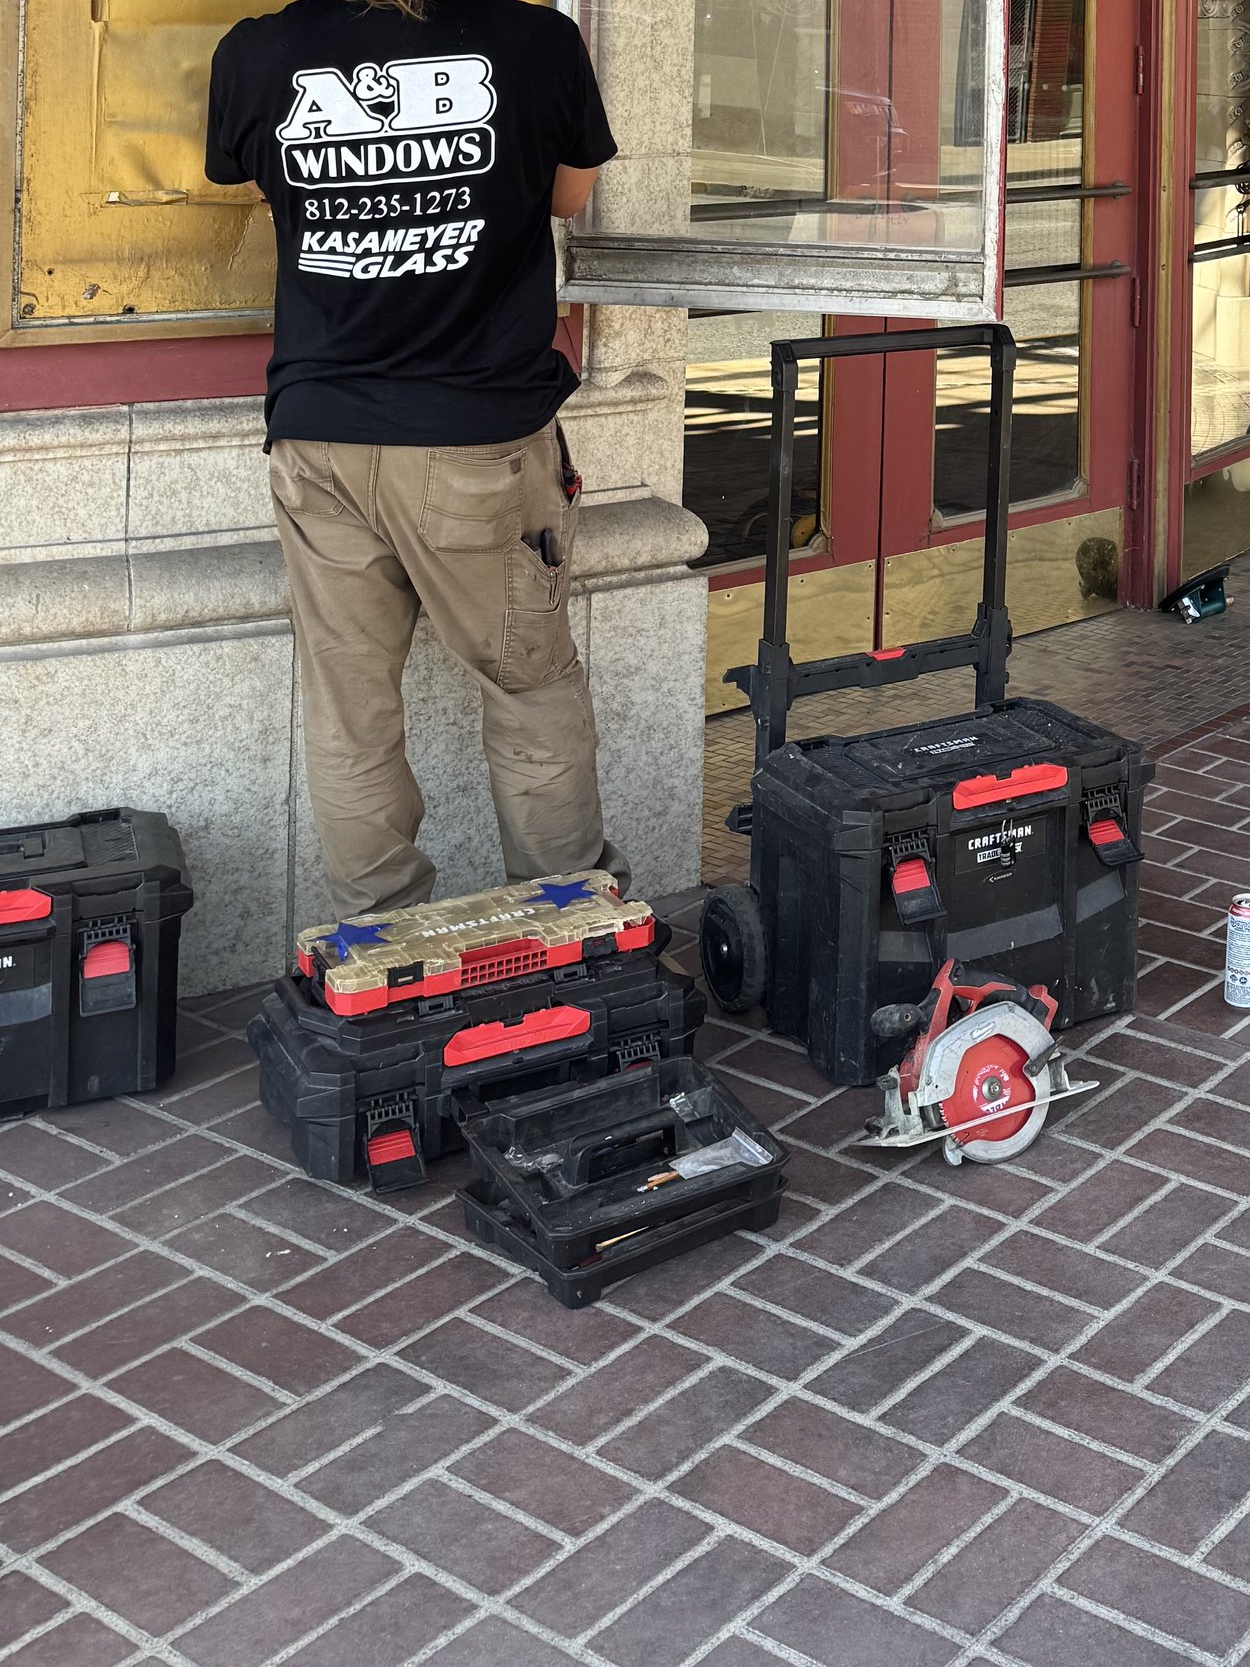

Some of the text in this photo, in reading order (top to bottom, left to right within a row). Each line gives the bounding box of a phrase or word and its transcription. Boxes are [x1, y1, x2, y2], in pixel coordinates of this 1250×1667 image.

[276, 54, 498, 143] A&B
[291, 133, 482, 179] WINDOWS
[304, 186, 471, 221] 812-235-1273
[301, 219, 485, 254] KASAMEYER
[352, 245, 475, 280] GLASS
[422, 908, 536, 937] CRAFTSMAN
